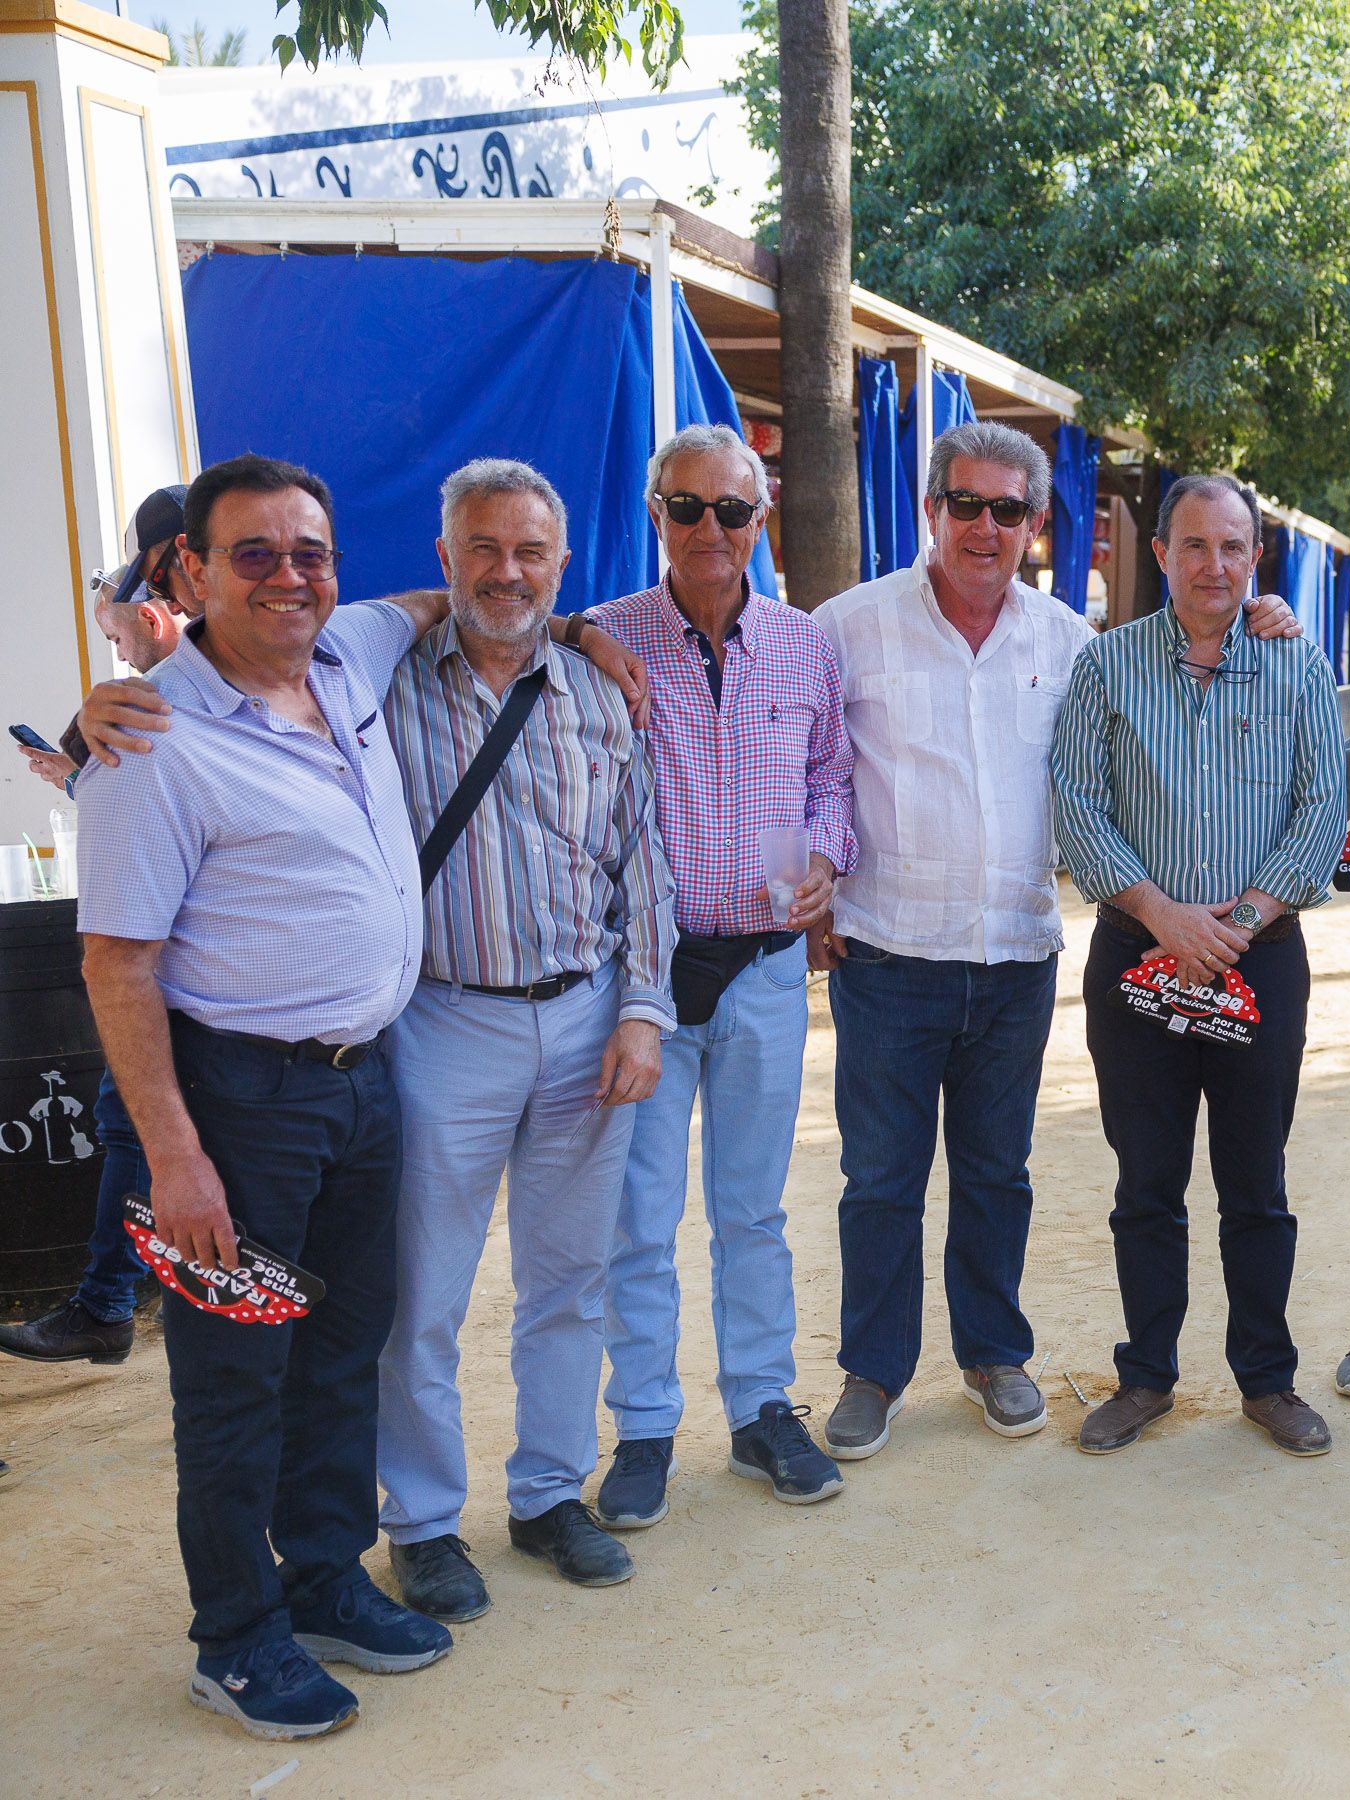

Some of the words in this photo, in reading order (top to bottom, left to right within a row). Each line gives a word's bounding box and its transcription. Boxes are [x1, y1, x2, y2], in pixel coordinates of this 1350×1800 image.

[1120, 982, 1155, 1000] Gana
[1127, 994, 1160, 1012] 100€
[1196, 1020, 1216, 1031] cara
[1216, 1026, 1252, 1044] bonita!!
[1211, 1016, 1234, 1028] por
[1234, 1023, 1248, 1033] tu
[135, 1213, 152, 1226] tu
[188, 1261, 268, 1306] RADIO
[252, 1260, 297, 1287] 100€
[261, 1277, 308, 1304] Gana
